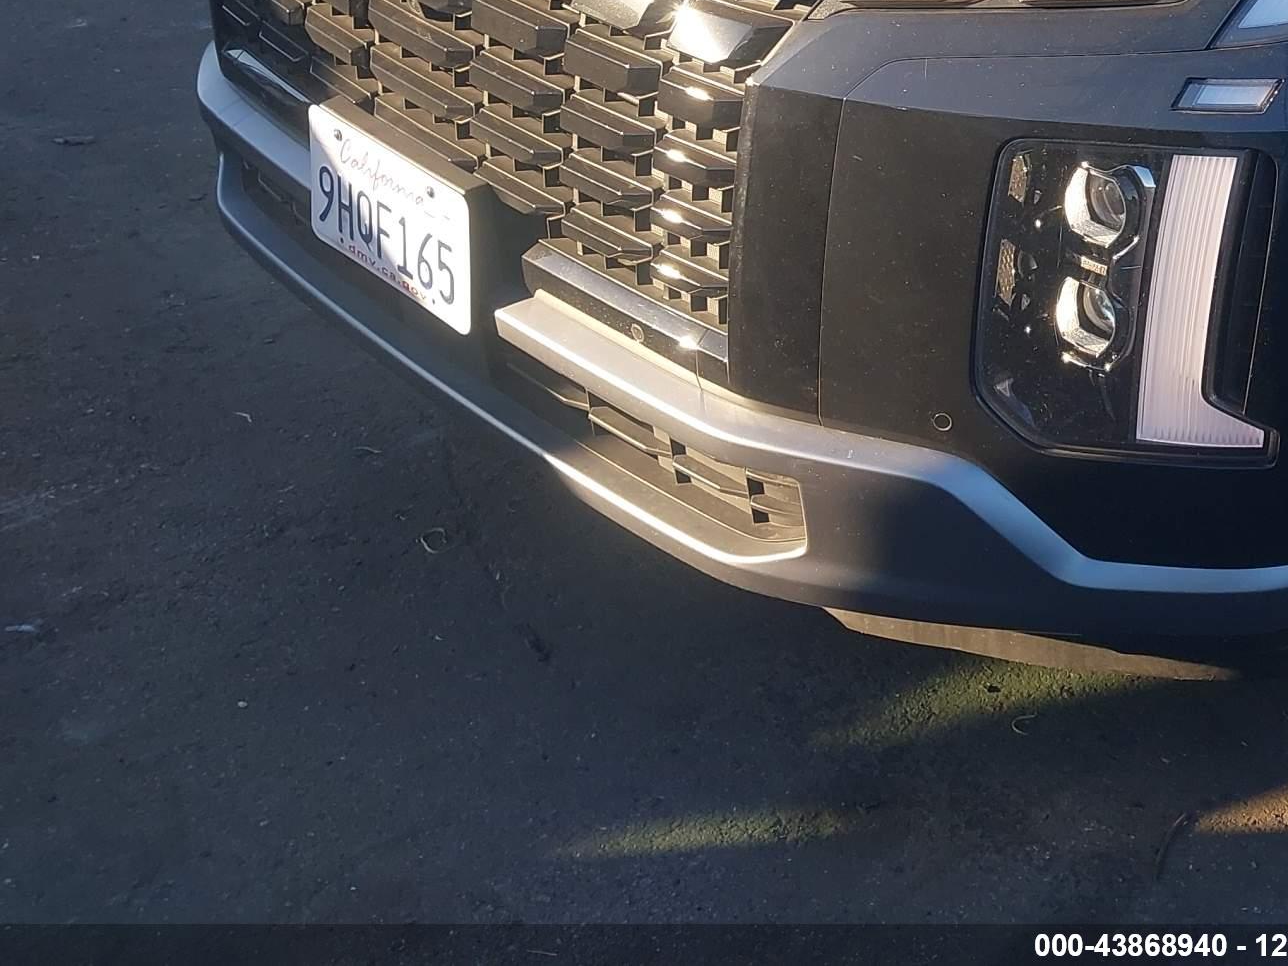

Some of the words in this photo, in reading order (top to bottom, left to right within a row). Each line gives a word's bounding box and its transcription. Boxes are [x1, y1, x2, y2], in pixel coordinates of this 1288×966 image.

[340, 139, 424, 205] California
[318, 165, 456, 305] 9HQF165
[348, 245, 428, 301] dmv.ca.gov
